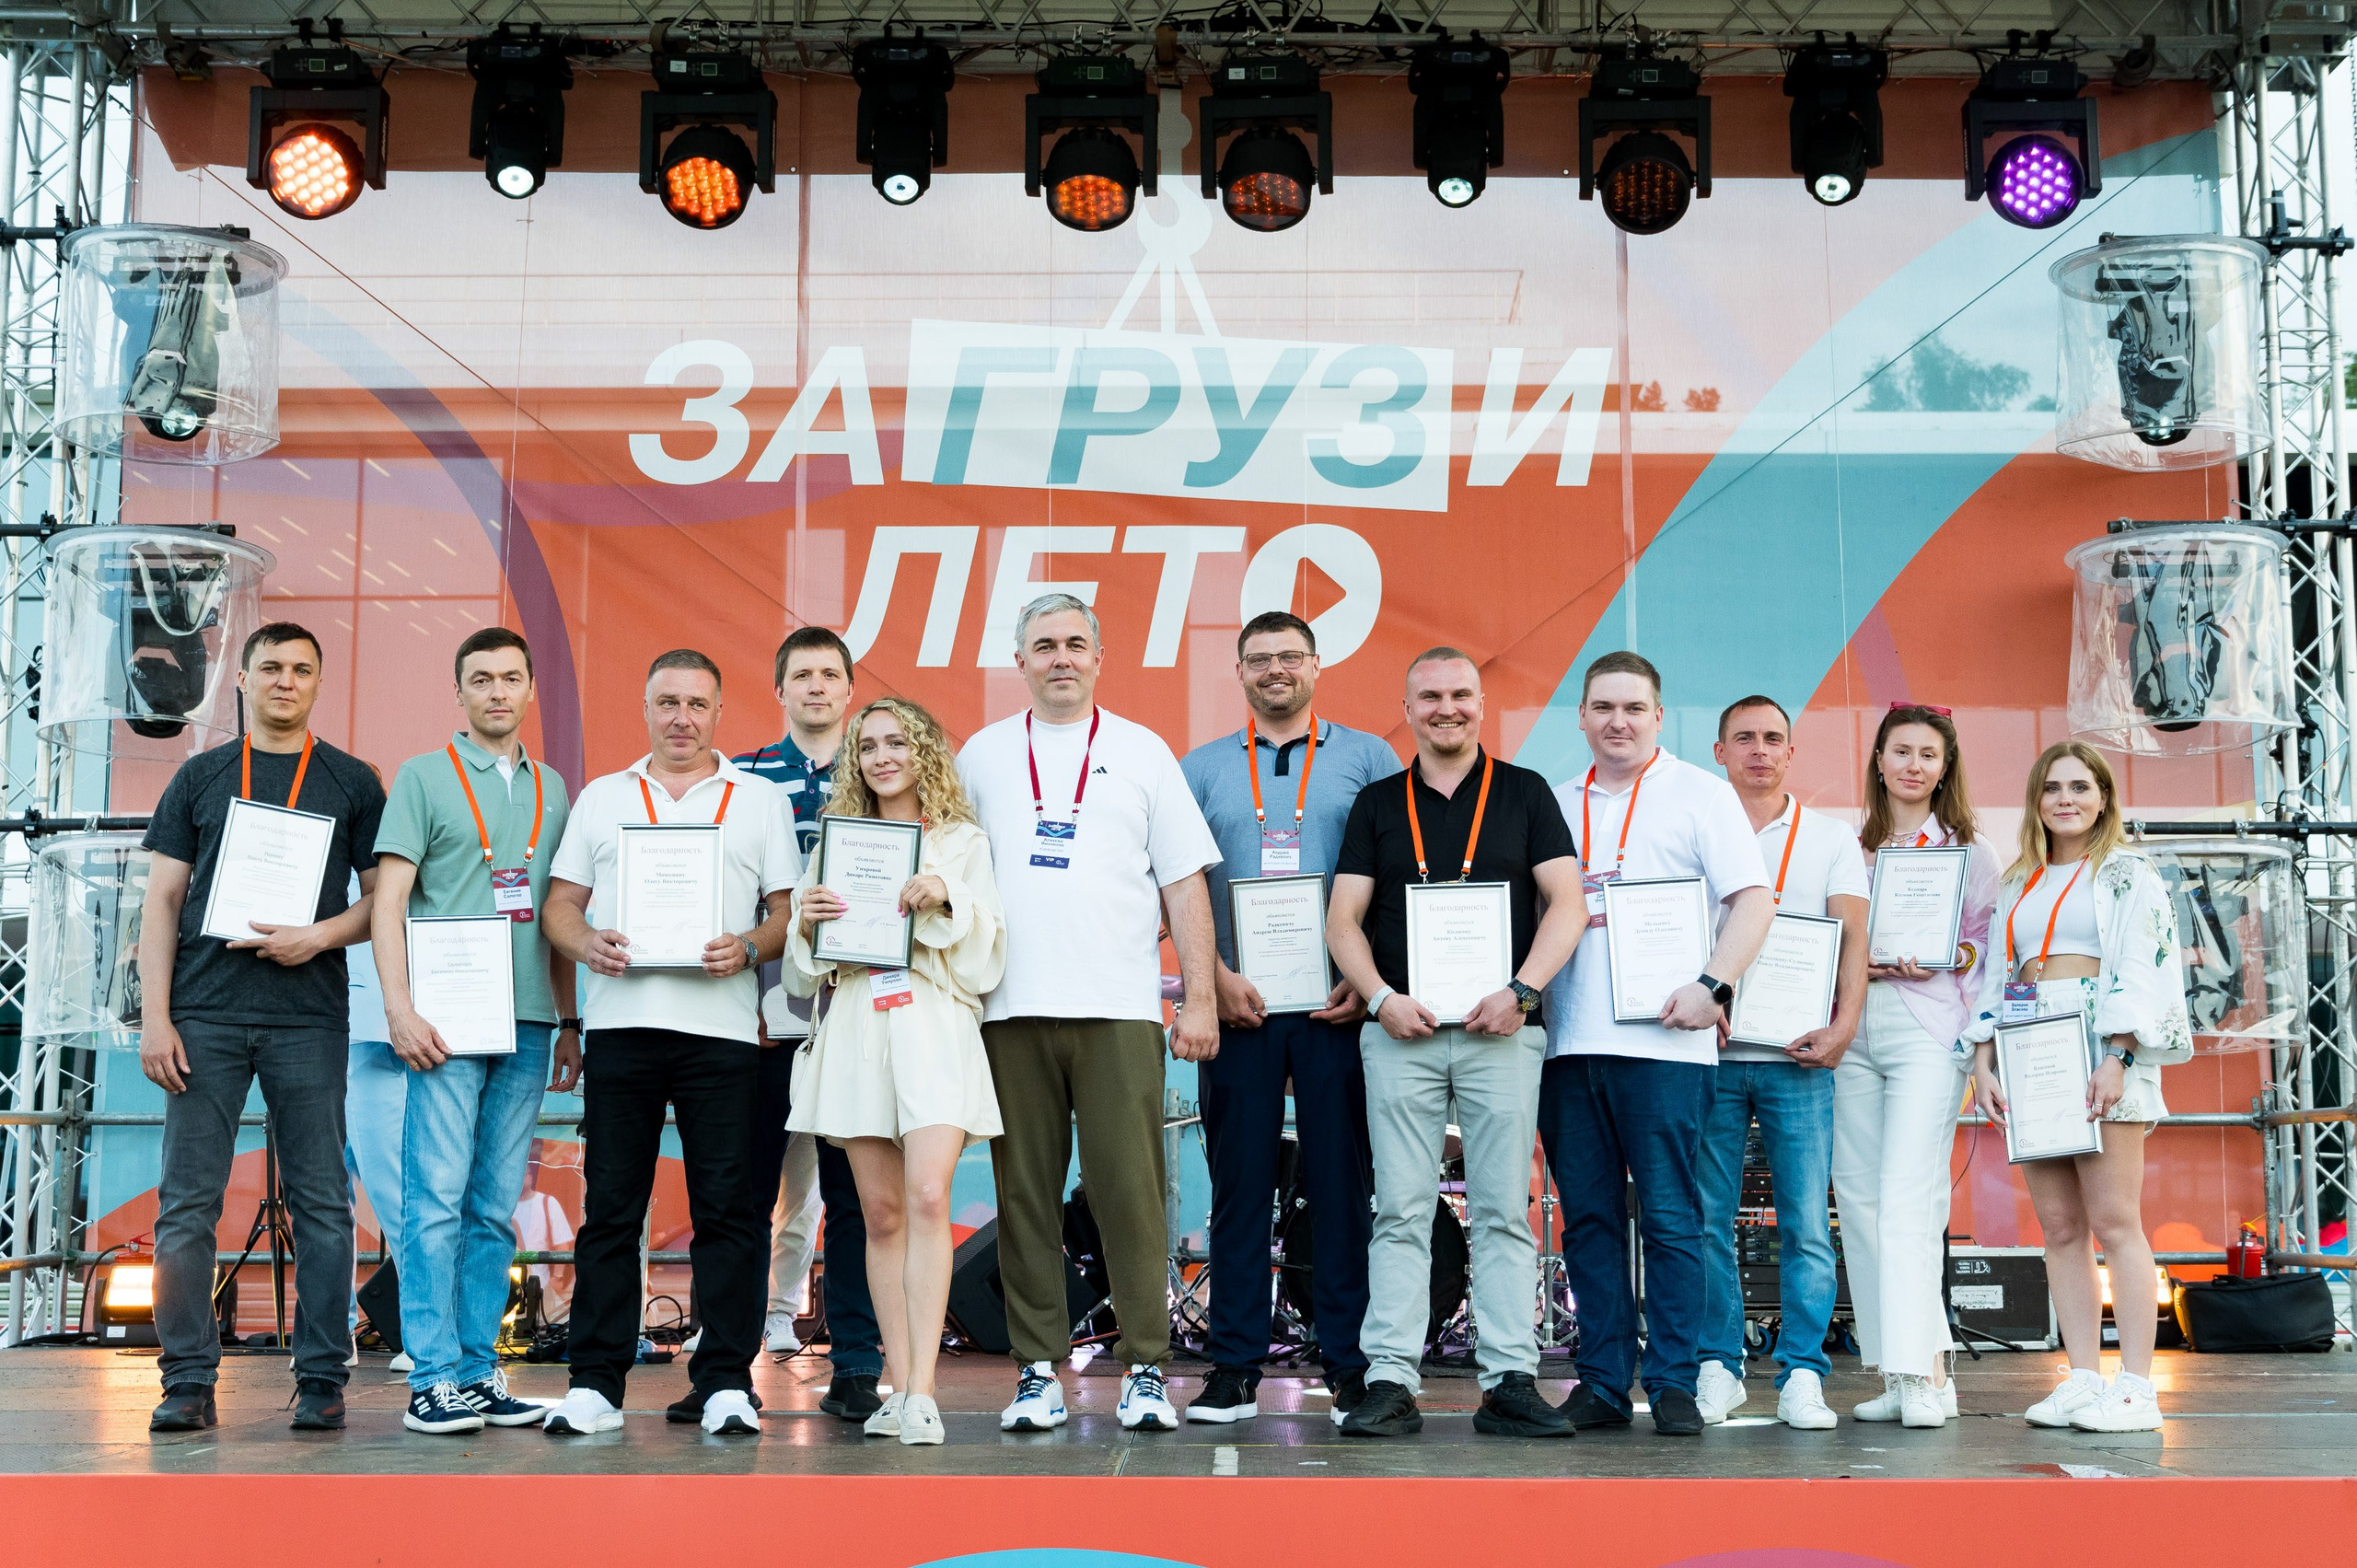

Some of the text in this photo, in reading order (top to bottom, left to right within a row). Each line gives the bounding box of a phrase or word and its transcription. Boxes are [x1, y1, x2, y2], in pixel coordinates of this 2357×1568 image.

[627, 339, 1613, 488] ЗАГРУЗИ
[842, 523, 1382, 669] ЛЕТО
[250, 822, 308, 840] Благодарность
[641, 846, 702, 855] Благодарность
[842, 838, 900, 851] Благодарность
[1894, 865, 1948, 874] Благодарность
[1251, 897, 1308, 907] Благодарность
[1626, 895, 1685, 905] Благодарность
[1429, 904, 1489, 913] Благодарность
[1767, 932, 1819, 944] лагодарность
[2015, 1037, 2069, 1051] Благодарность
